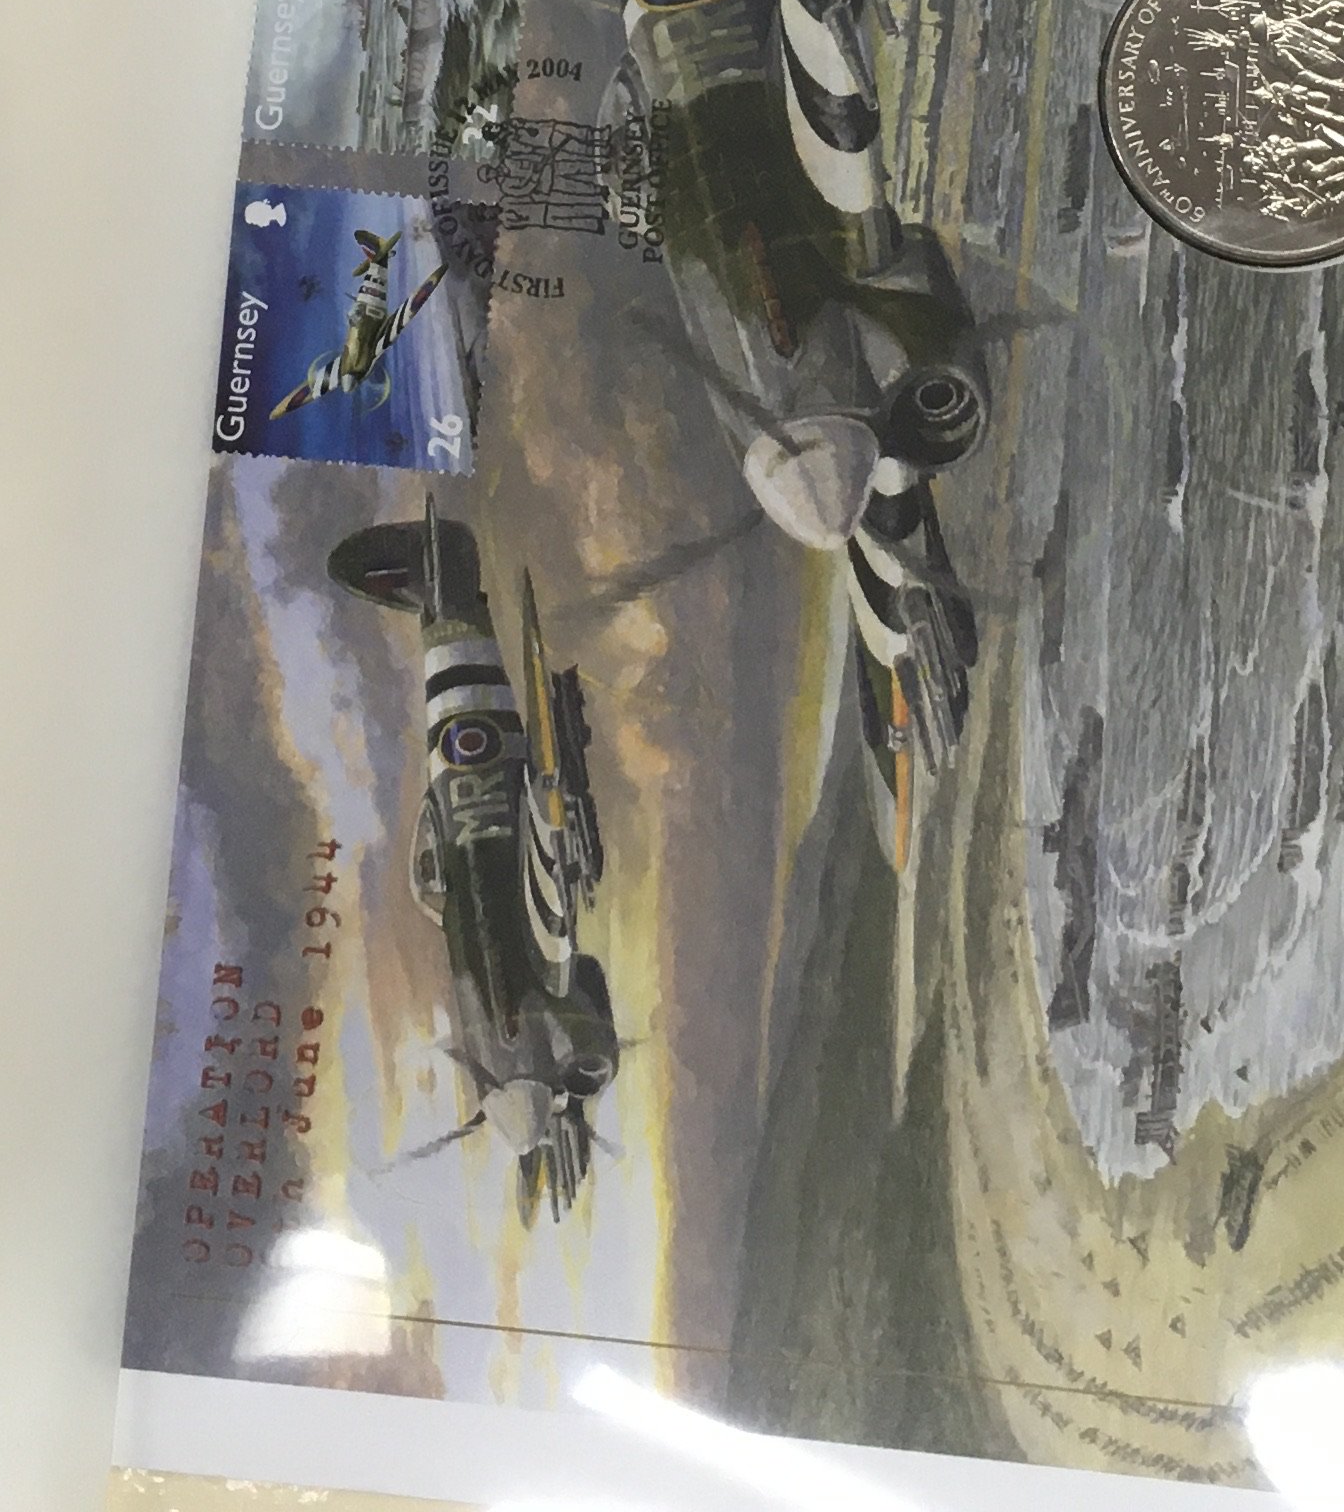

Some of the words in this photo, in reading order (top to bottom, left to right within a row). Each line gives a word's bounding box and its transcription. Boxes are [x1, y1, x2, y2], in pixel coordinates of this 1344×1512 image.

[526, 58, 583, 81] 2004
[1116, 25, 1171, 189] ANNIVERSARY
[498, 270, 564, 298] FIRST
[216, 291, 269, 443] Guernsey
[428, 414, 463, 458] 26
[302, 839, 343, 961] 1944
[182, 961, 244, 1263] OPERATION
[276, 1006, 324, 1134] June
